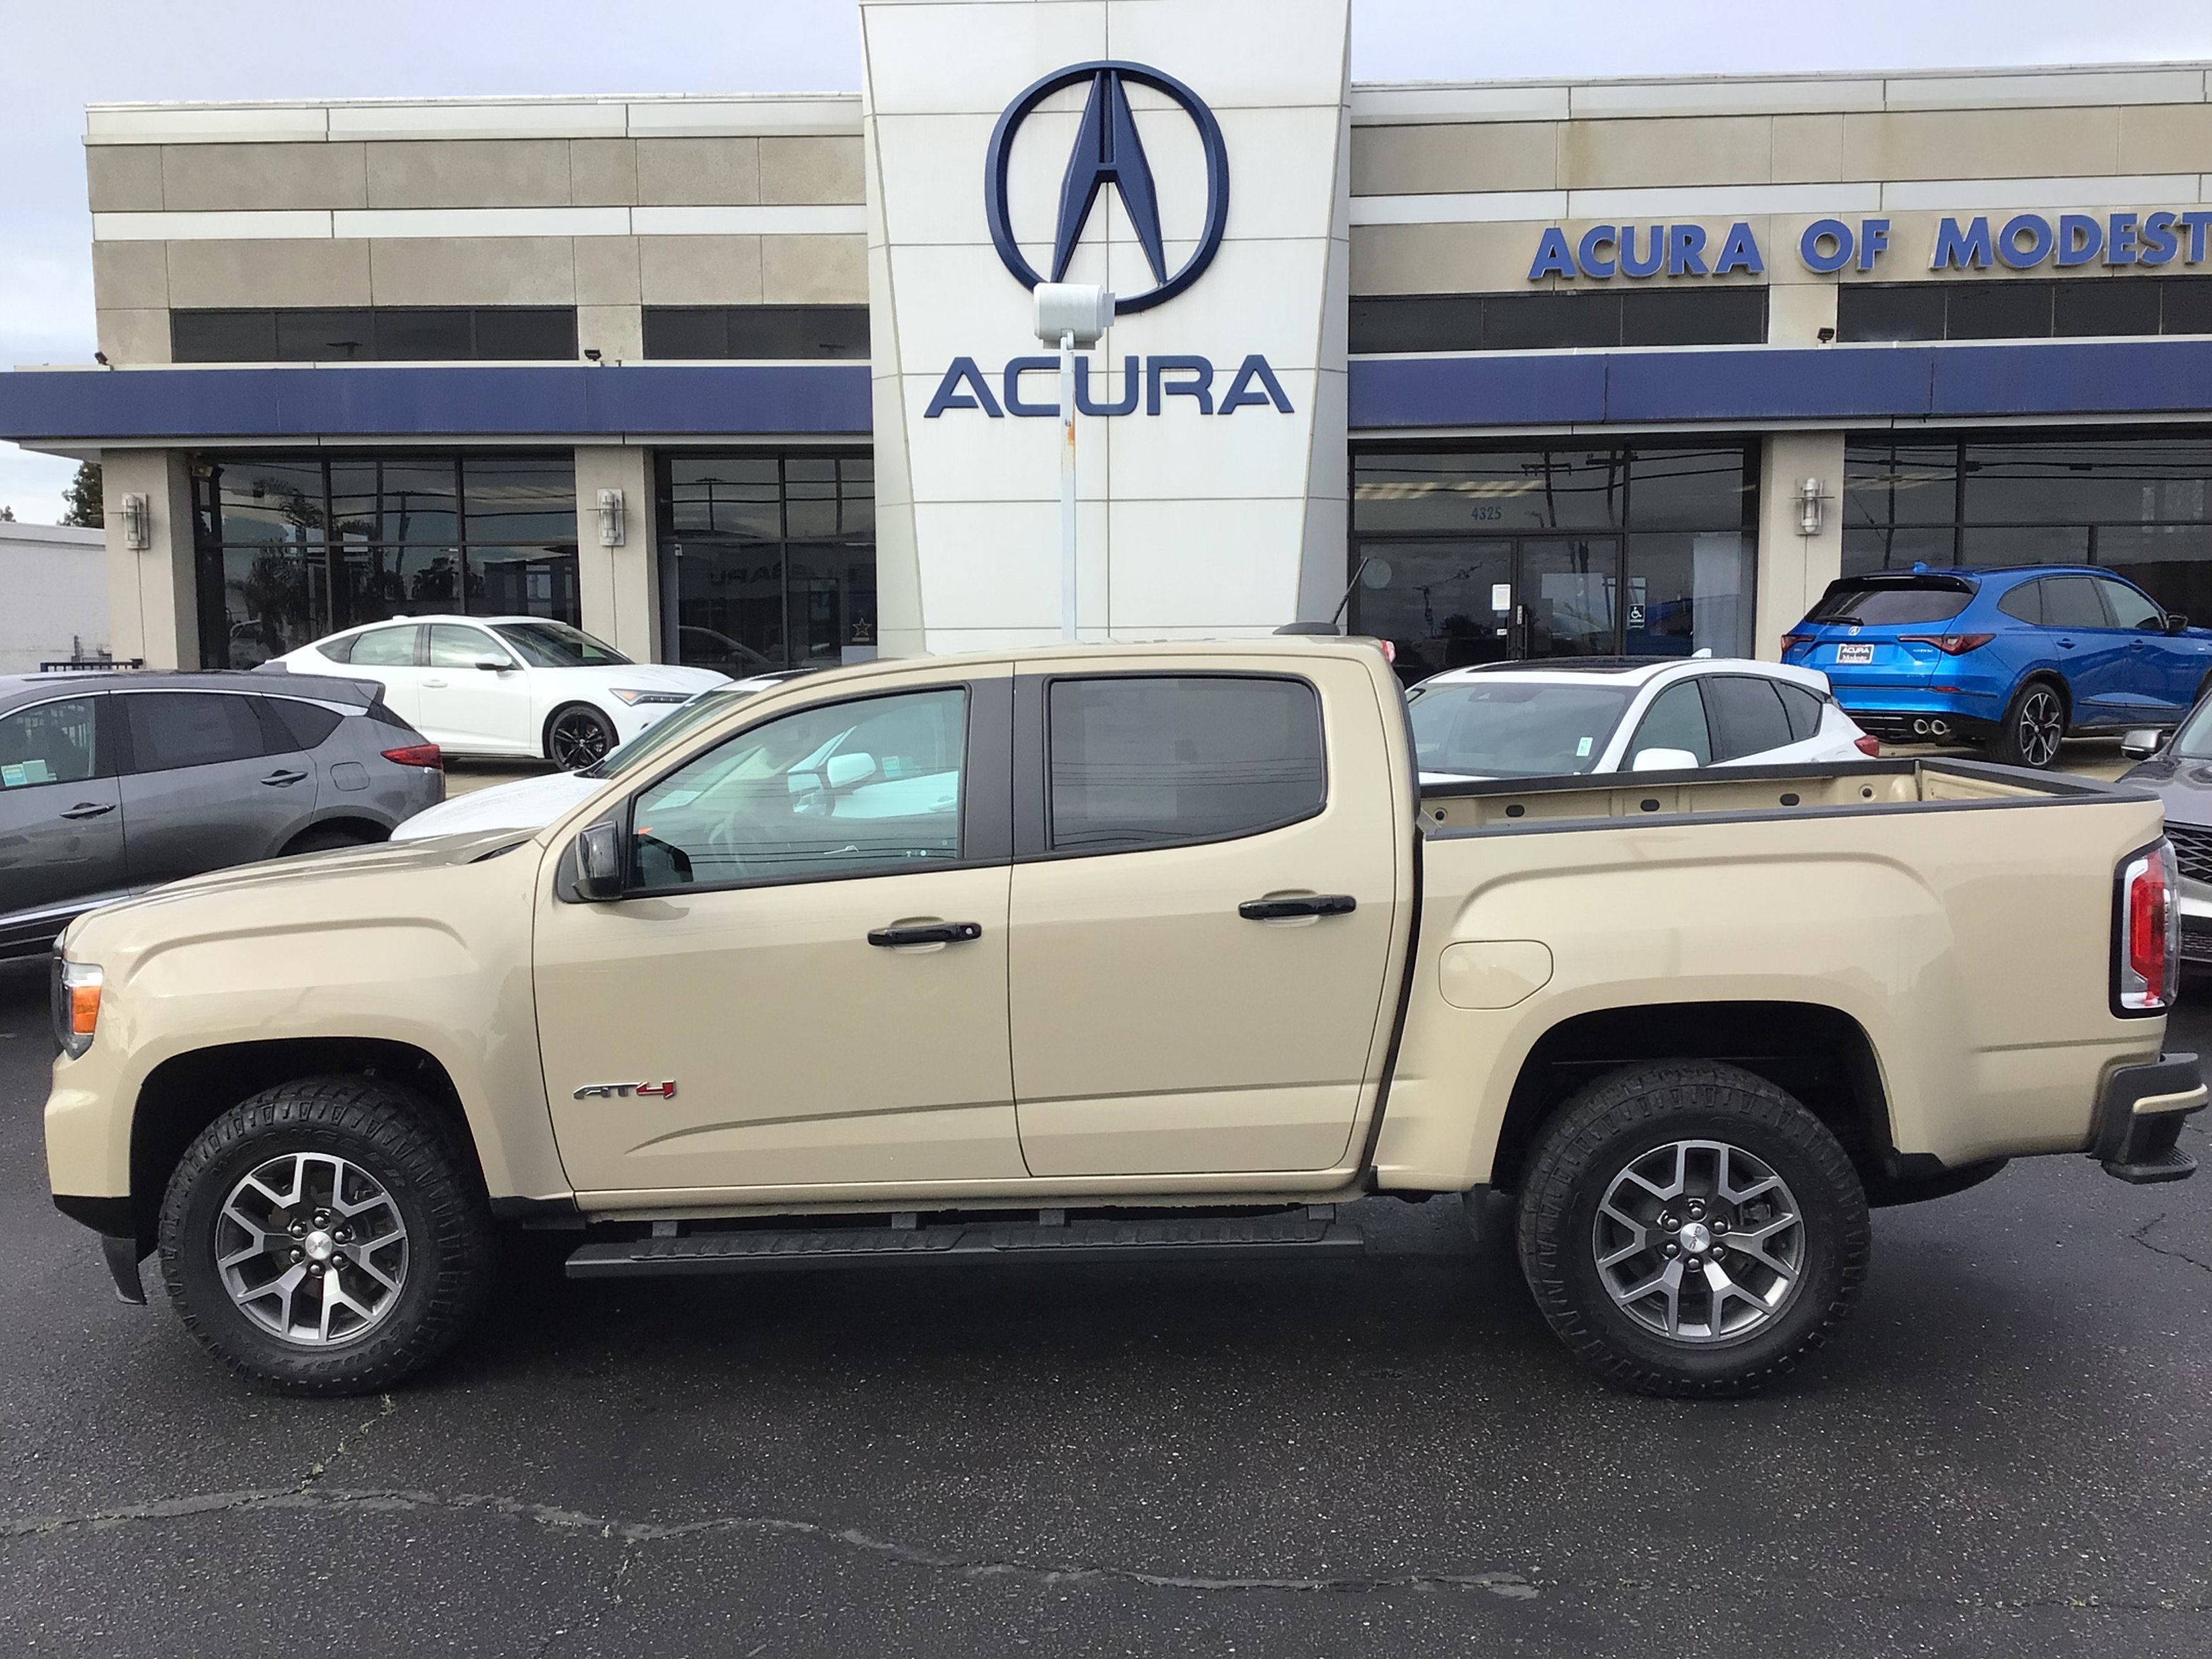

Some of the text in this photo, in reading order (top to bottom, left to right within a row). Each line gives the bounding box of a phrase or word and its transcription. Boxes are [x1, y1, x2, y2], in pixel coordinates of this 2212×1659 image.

[1527, 211, 2212, 279] ACURA OF MODEST
[924, 354, 1294, 418] ACURA
[1471, 506, 1502, 520] 4325
[573, 1080, 676, 1099] AT4
[1689, 1225, 1702, 1250] GMC
